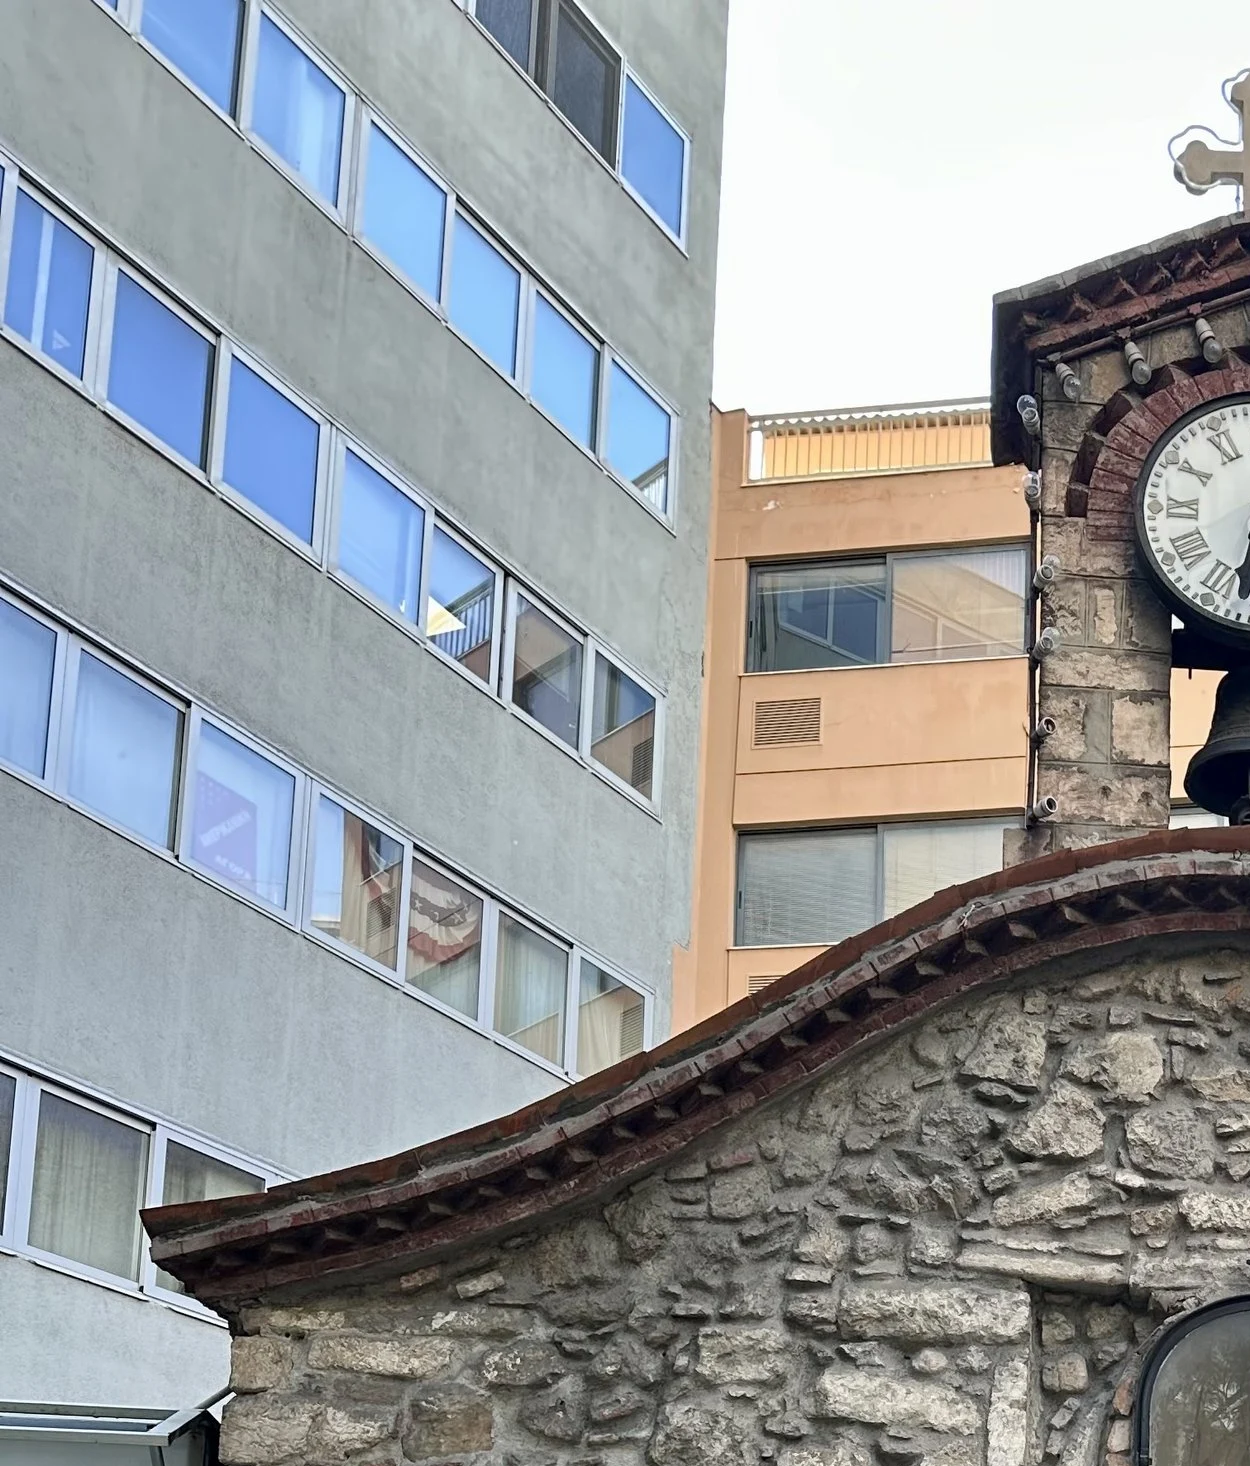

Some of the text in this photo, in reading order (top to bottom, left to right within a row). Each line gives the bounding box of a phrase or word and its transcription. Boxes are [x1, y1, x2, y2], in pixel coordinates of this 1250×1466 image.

[1207, 429, 1243, 465] XI
[1178, 457, 1213, 486] X
[1166, 494, 1199, 520] IX
[1169, 527, 1211, 570] VIII
[1200, 559, 1237, 600] VII
